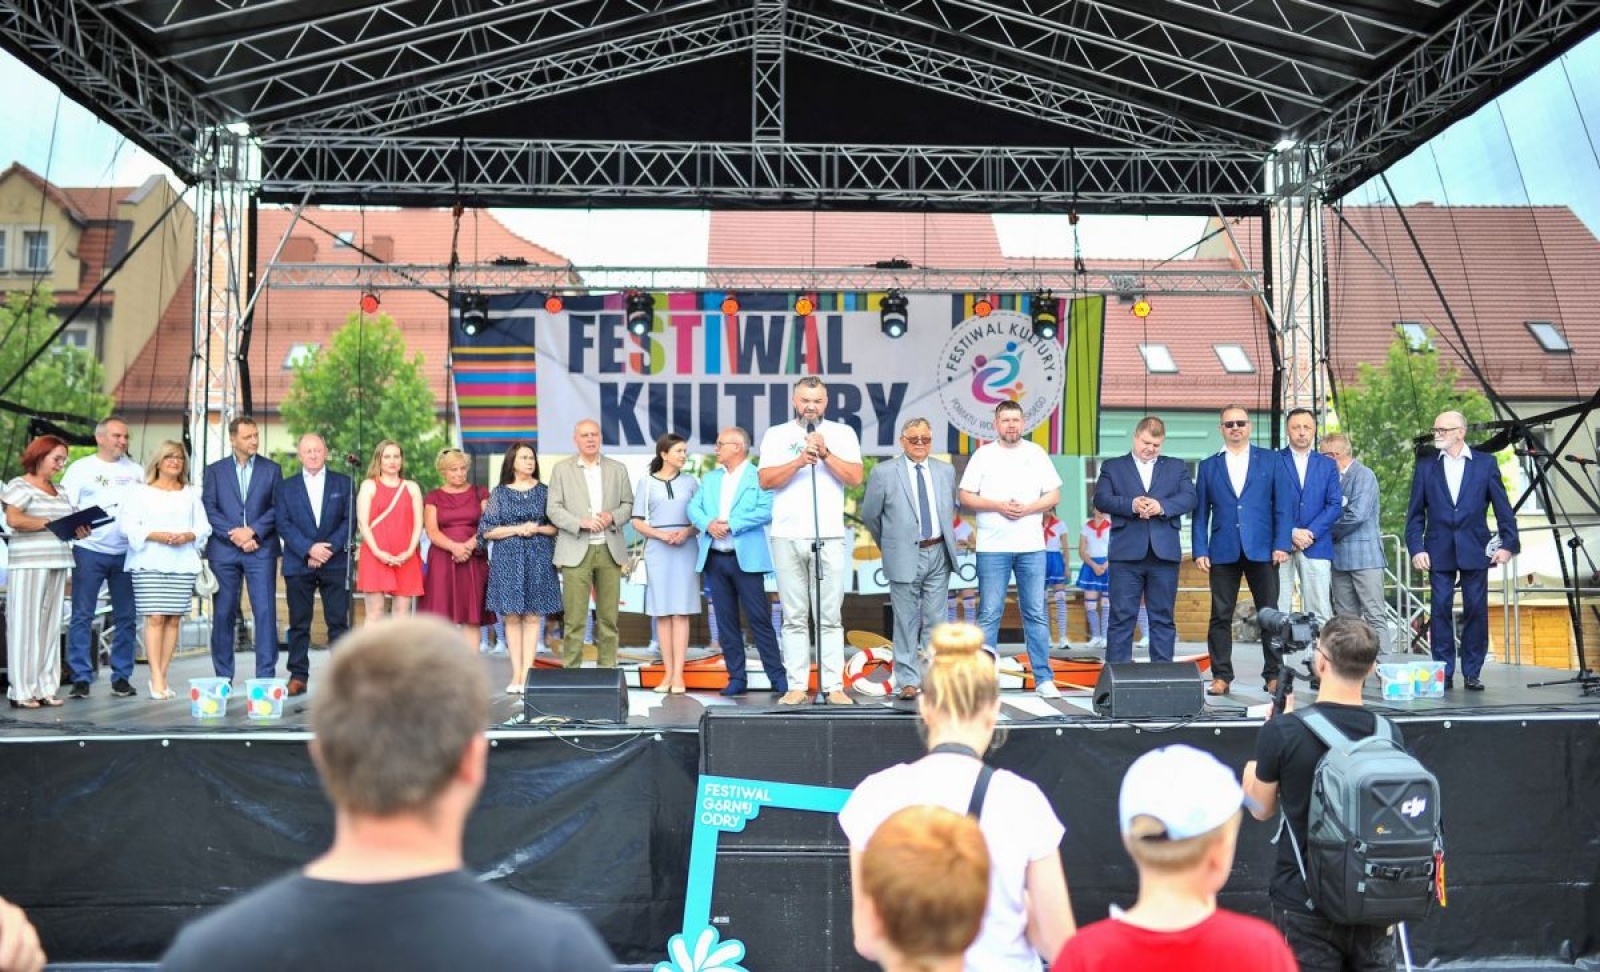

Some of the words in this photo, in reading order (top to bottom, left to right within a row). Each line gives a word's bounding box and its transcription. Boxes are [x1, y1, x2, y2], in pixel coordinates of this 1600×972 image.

[568, 314, 853, 375] FESTIWAL
[947, 321, 1004, 371] FESTIWAL
[1008, 322, 1055, 371] KULTURY
[704, 783, 773, 802] FESTIWAL
[700, 811, 740, 828] ODRY
